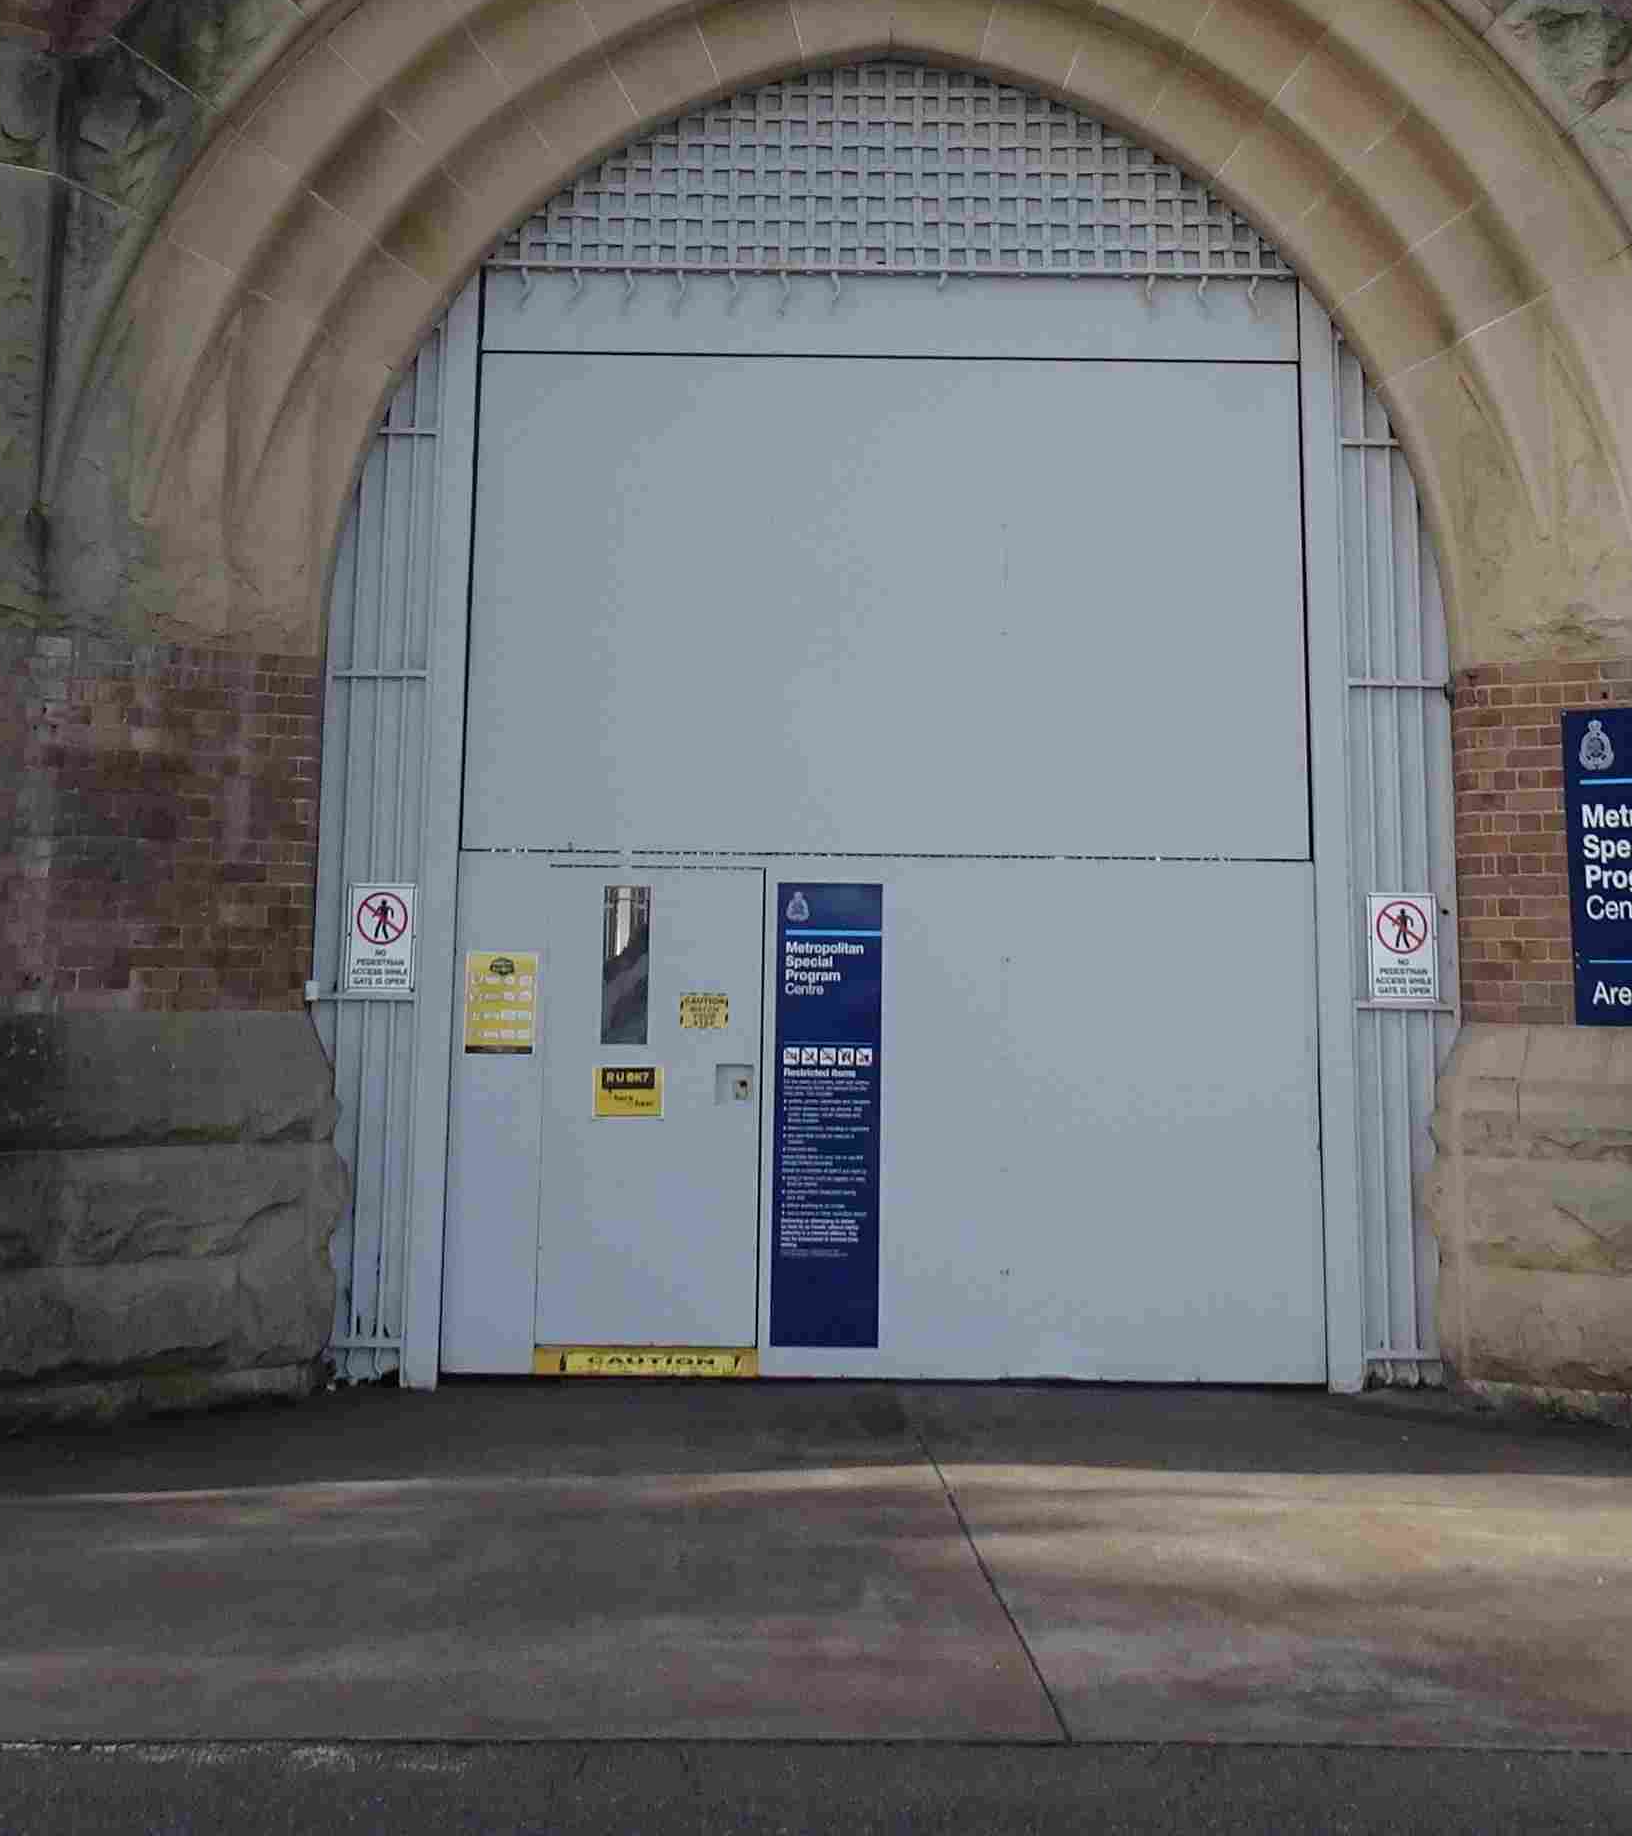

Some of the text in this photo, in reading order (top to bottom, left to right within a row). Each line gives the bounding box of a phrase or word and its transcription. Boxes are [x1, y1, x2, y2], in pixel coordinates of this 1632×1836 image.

[785, 941, 865, 956] Metropolitan
[785, 955, 833, 969] Special
[784, 968, 841, 983] Program
[784, 982, 824, 996] Centre
[784, 1068, 829, 1077] Restricted
[587, 1353, 716, 1365] CAUTION
